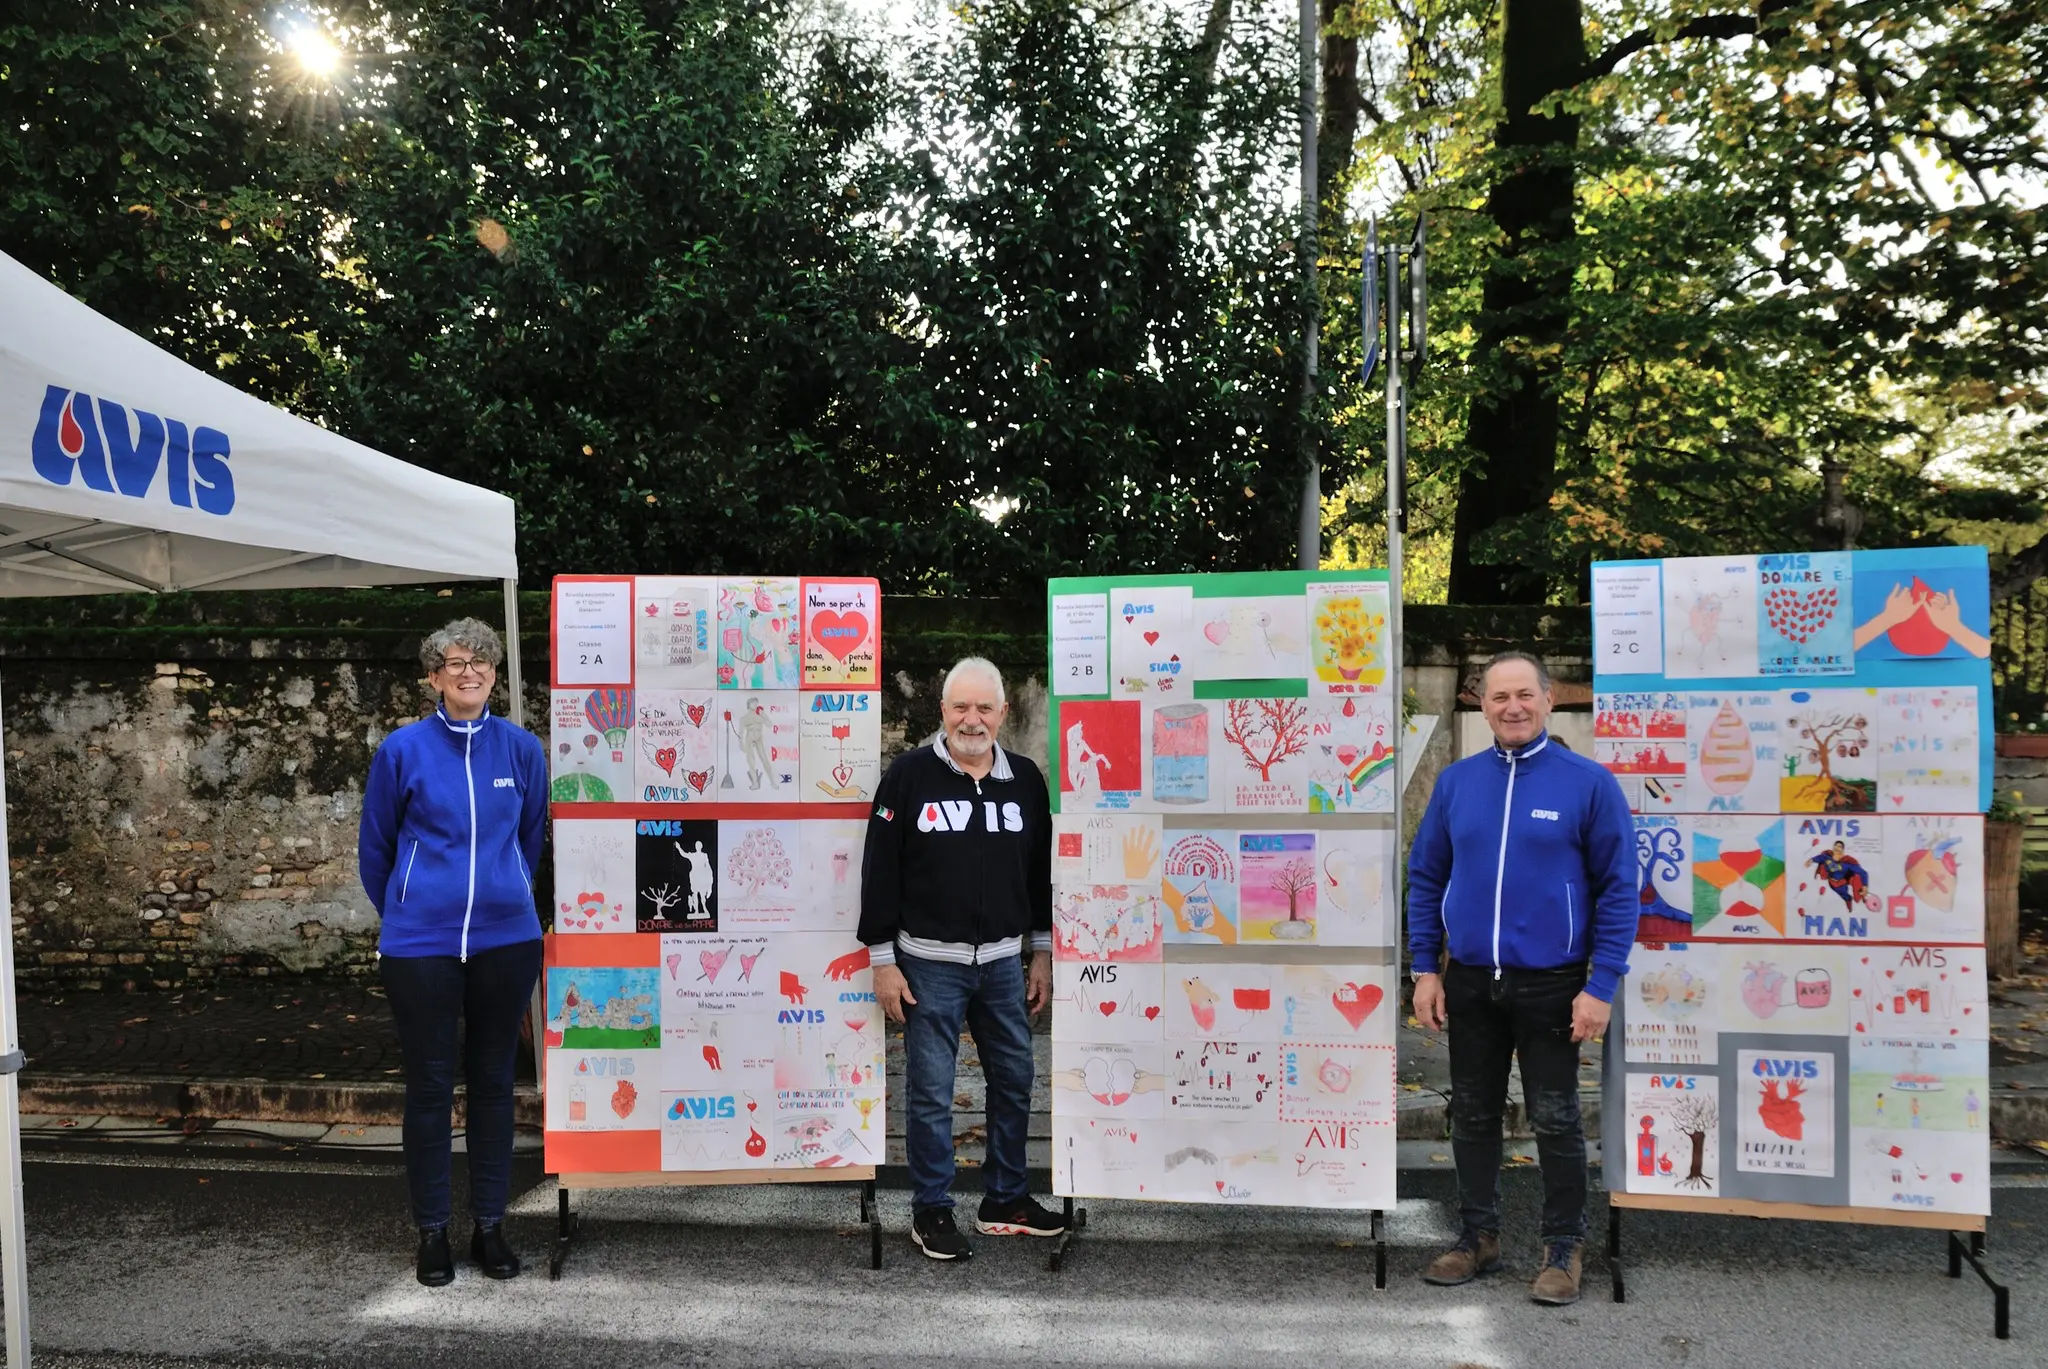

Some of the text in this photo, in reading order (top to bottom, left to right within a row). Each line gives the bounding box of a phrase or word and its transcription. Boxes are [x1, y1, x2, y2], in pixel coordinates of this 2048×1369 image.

[32, 384, 236, 516] AVIS
[1758, 555, 1810, 570] AVIS
[1762, 571, 1822, 584] DONARE
[809, 595, 825, 608] Non
[840, 602, 853, 611] per
[855, 598, 866, 608] chi
[1613, 642, 1640, 654] 2 C
[580, 654, 603, 665] 2 A
[849, 663, 868, 672] dono
[1071, 665, 1094, 676] 2 B
[811, 694, 869, 713] AVIS
[644, 785, 689, 802] AVIS
[917, 800, 1024, 833] AVIS
[1087, 817, 1113, 829] AVIS
[637, 820, 683, 837] AVIS
[1798, 818, 1860, 837] AVIS
[1804, 914, 1868, 937] MAN
[1900, 947, 1947, 968] AVIS
[1079, 964, 1117, 984] AVIS
[838, 991, 877, 1003] AVIS
[1800, 984, 1829, 996] AVIS
[778, 1009, 826, 1024] AVIS
[574, 1056, 636, 1076] AVIS
[1752, 1058, 1818, 1079] AVIS
[1650, 1074, 1696, 1090] AVIS
[667, 1095, 736, 1121] AVIS
[1306, 1108, 1334, 1116] donare
[1104, 1126, 1127, 1138] AVIS
[1305, 1125, 1360, 1150] AVIS
